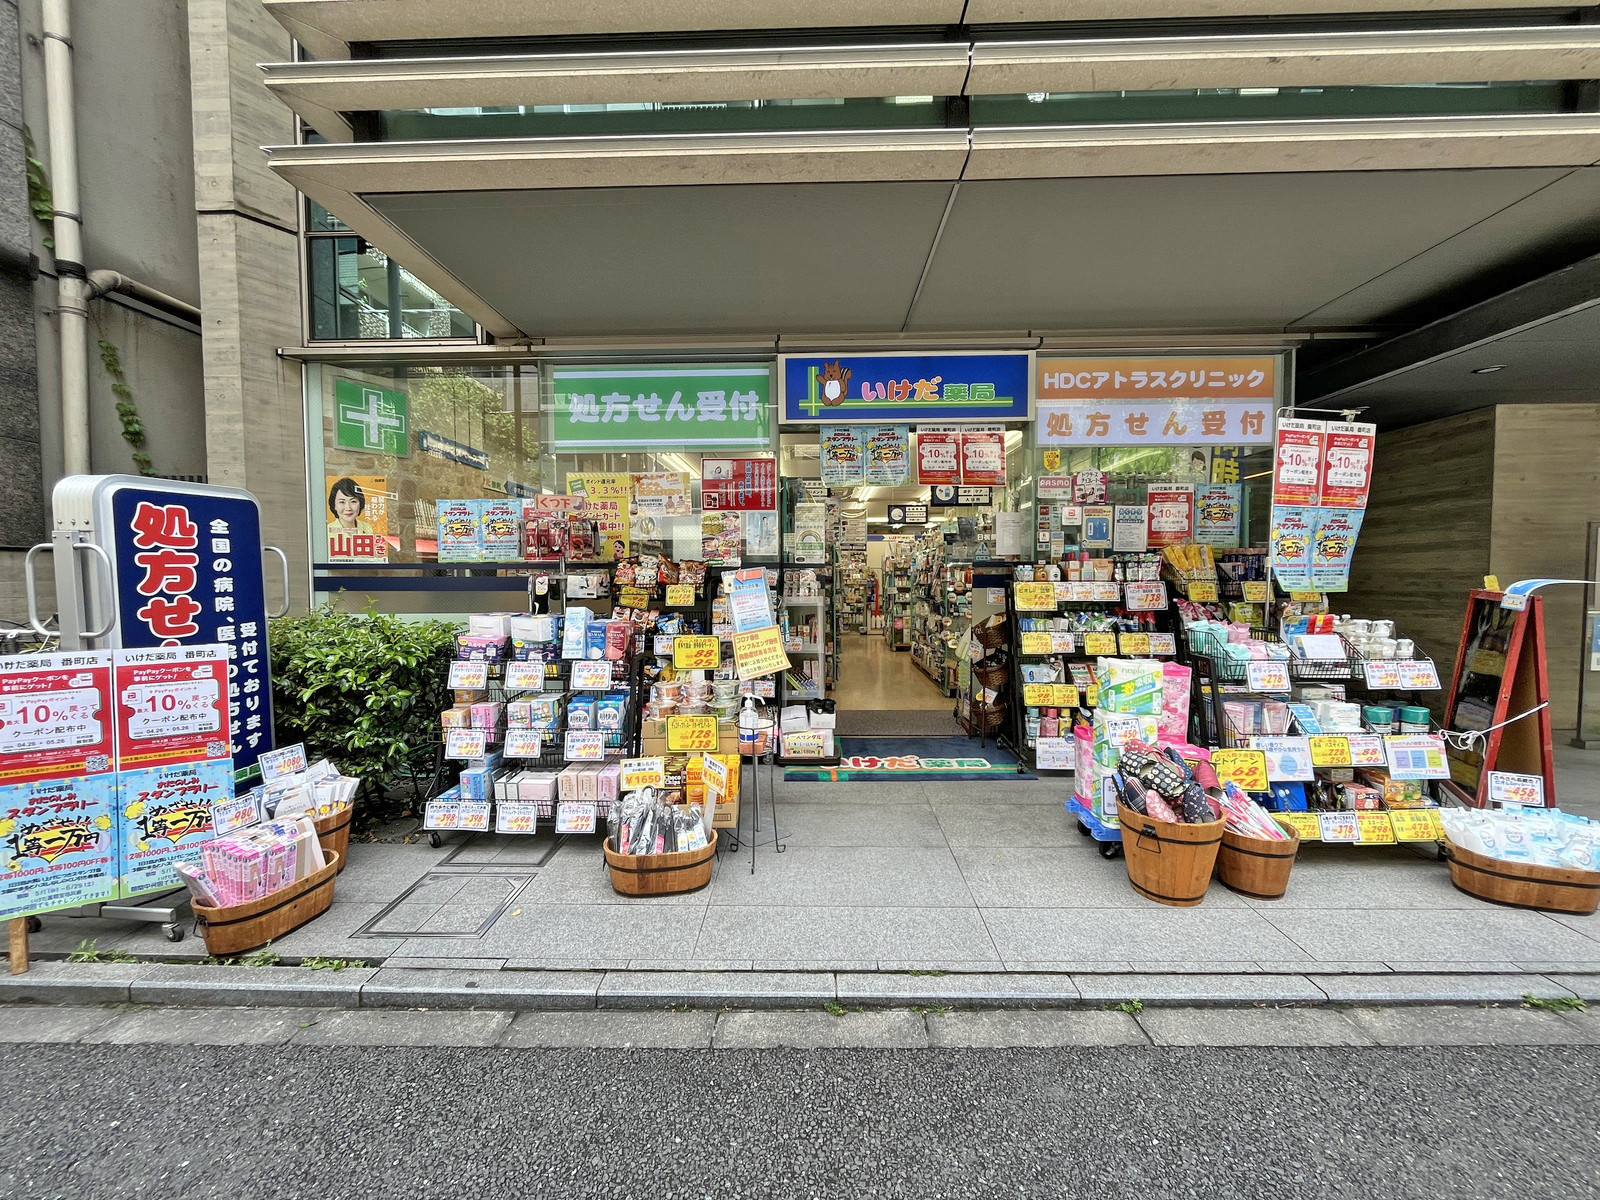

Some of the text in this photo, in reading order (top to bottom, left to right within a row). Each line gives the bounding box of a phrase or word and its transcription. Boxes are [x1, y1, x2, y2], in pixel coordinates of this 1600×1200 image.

[1044, 369, 1265, 390] HDCアトラスクリニック
[861, 375, 996, 402] いけだ薬局
[569, 391, 759, 423] 処方せん受付
[1046, 410, 1266, 438] 処方せん受付
[1039, 479, 1070, 488] PASMO
[539, 498, 571, 508] くつ下
[585, 501, 618, 511] けだ薬局
[600, 521, 625, 531] 集中!!
[330, 533, 386, 557] 山田 みき
[131, 501, 202, 647] 処方せ
[125, 649, 217, 663] いけだ薬局 番町店
[694, 649, 714, 658] 88
[61, 656, 98, 670] 番町店
[693, 658, 715, 667] 95
[1122, 666, 1145, 675] nepia
[239, 621, 262, 748] 受付ております
[146, 694, 192, 713] 10%
[17, 704, 69, 725] 10%
[142, 713, 206, 727] クーポン配布中
[12, 725, 86, 739] クーポン配布中
[690, 730, 711, 739] 128
[582, 743, 599, 751] 999
[690, 740, 711, 748] 138
[1328, 748, 1345, 756] 228
[1232, 766, 1259, 776] 68
[626, 774, 661, 785] ¥1650
[137, 783, 220, 803] スタンプラリー
[1512, 787, 1535, 796] 458
[6, 799, 100, 820] スタンプラリー
[234, 806, 253, 823] 980
[440, 813, 456, 822] 398
[469, 814, 483, 822] 398
[1371, 825, 1387, 833] 298
[1411, 823, 1429, 831] 478
[1414, 830, 1432, 838] 525
[4, 827, 101, 861] 1等一万円
